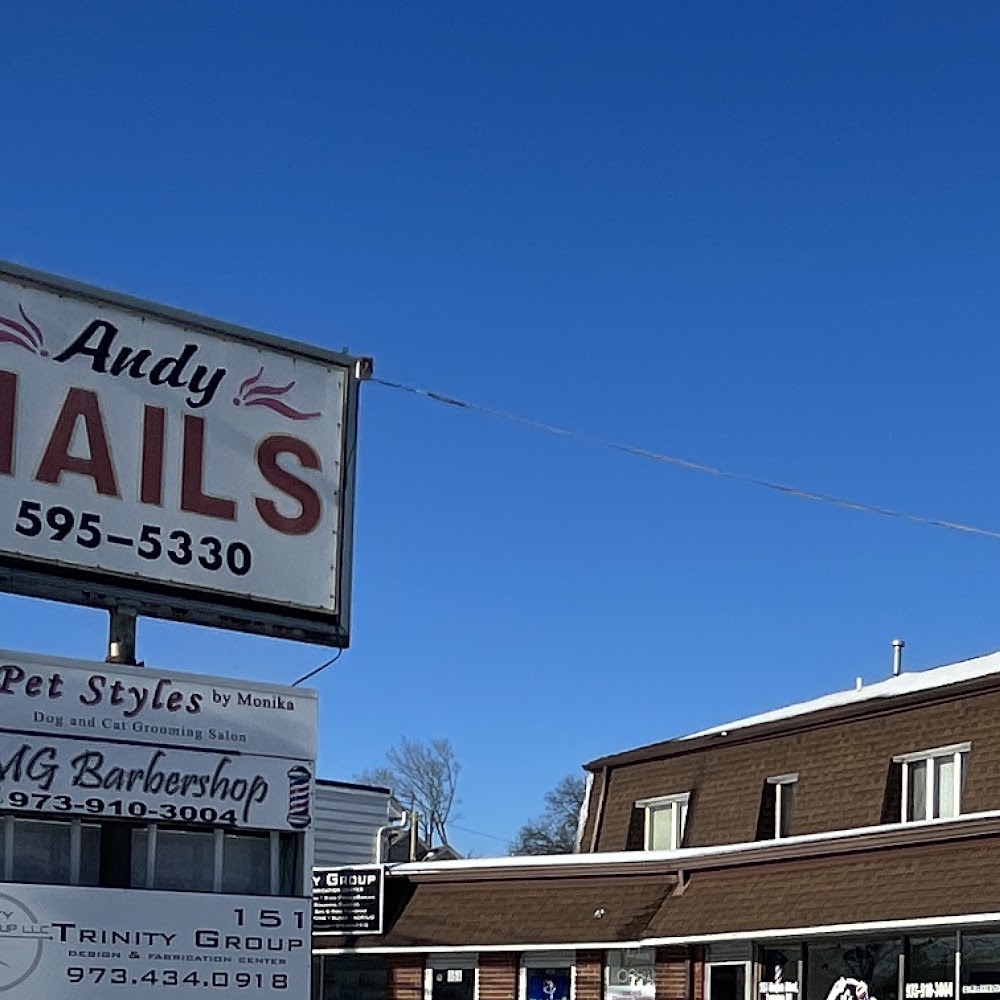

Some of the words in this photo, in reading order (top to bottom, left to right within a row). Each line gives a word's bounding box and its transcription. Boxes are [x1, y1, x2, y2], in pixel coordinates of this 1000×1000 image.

[53, 319, 227, 408] Andy
[15, 500, 252, 575] 595-5330
[0, 665, 64, 699] Pet
[80, 675, 203, 718] Styles
[212, 689, 231, 707] by
[237, 692, 296, 711] Monika
[33, 711, 63, 727] Dog
[70, 716, 95, 729] and
[102, 718, 127, 731] Cat
[132, 721, 203, 741] Grooming
[208, 728, 247, 743] Salon
[70, 750, 269, 823] Barbershop
[9, 791, 238, 825] 973-910-3004
[234, 908, 304, 929] 151
[51, 922, 177, 947] TRINITY
[195, 930, 304, 953] GROUP
[68, 950, 121, 959] DESIGN
[129, 951, 140, 959] &
[148, 953, 232, 963] FABRICATION
[238, 957, 287, 965] CENTER
[67, 967, 289, 989] 973.434.0918
